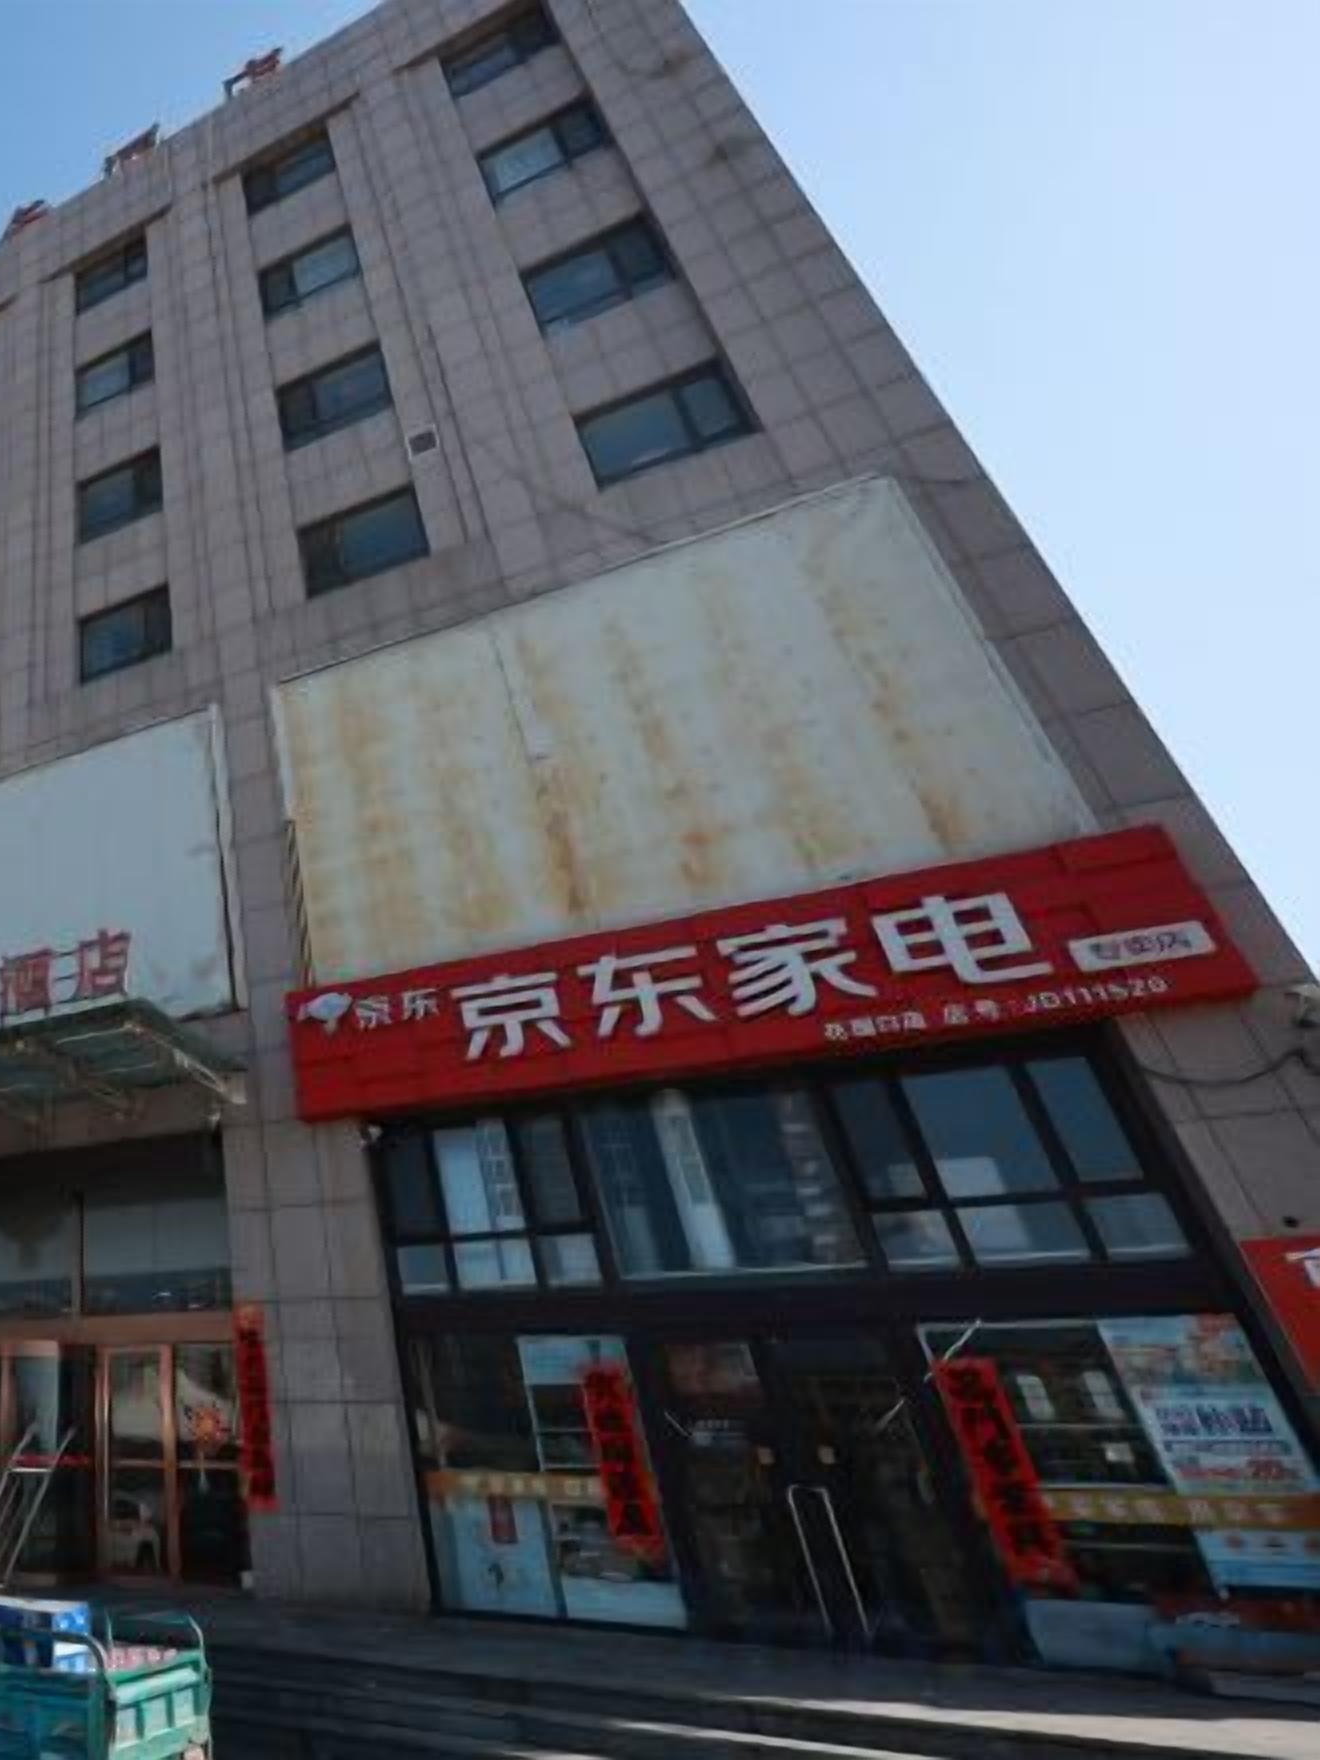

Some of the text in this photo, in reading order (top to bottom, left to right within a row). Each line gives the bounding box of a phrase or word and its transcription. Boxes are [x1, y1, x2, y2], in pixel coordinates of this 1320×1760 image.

[354, 988, 441, 1030] 京东
[449, 891, 1054, 1061] 京东家电
